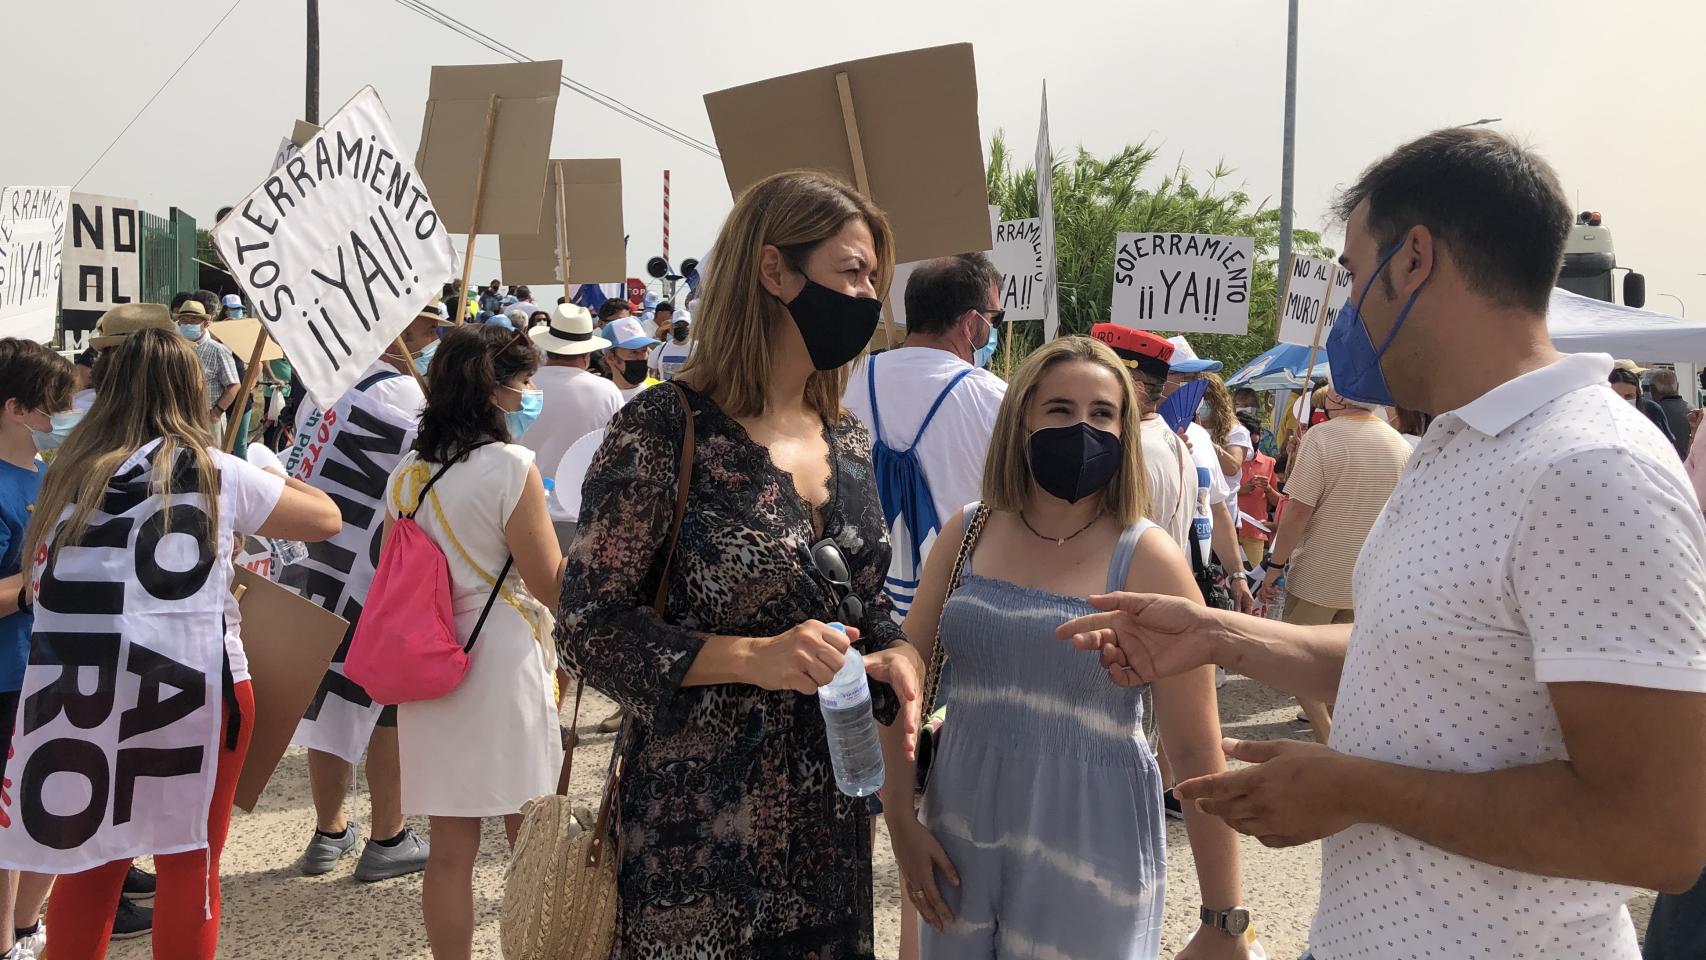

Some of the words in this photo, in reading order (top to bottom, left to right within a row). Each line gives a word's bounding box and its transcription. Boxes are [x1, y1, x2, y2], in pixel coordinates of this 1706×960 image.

[72, 203, 136, 253] NO
[79, 265, 131, 303] AL
[1293, 258, 1310, 278] NO
[1313, 264, 1327, 280] AL
[1285, 291, 1320, 324] MURO
[113, 642, 206, 827] AL
